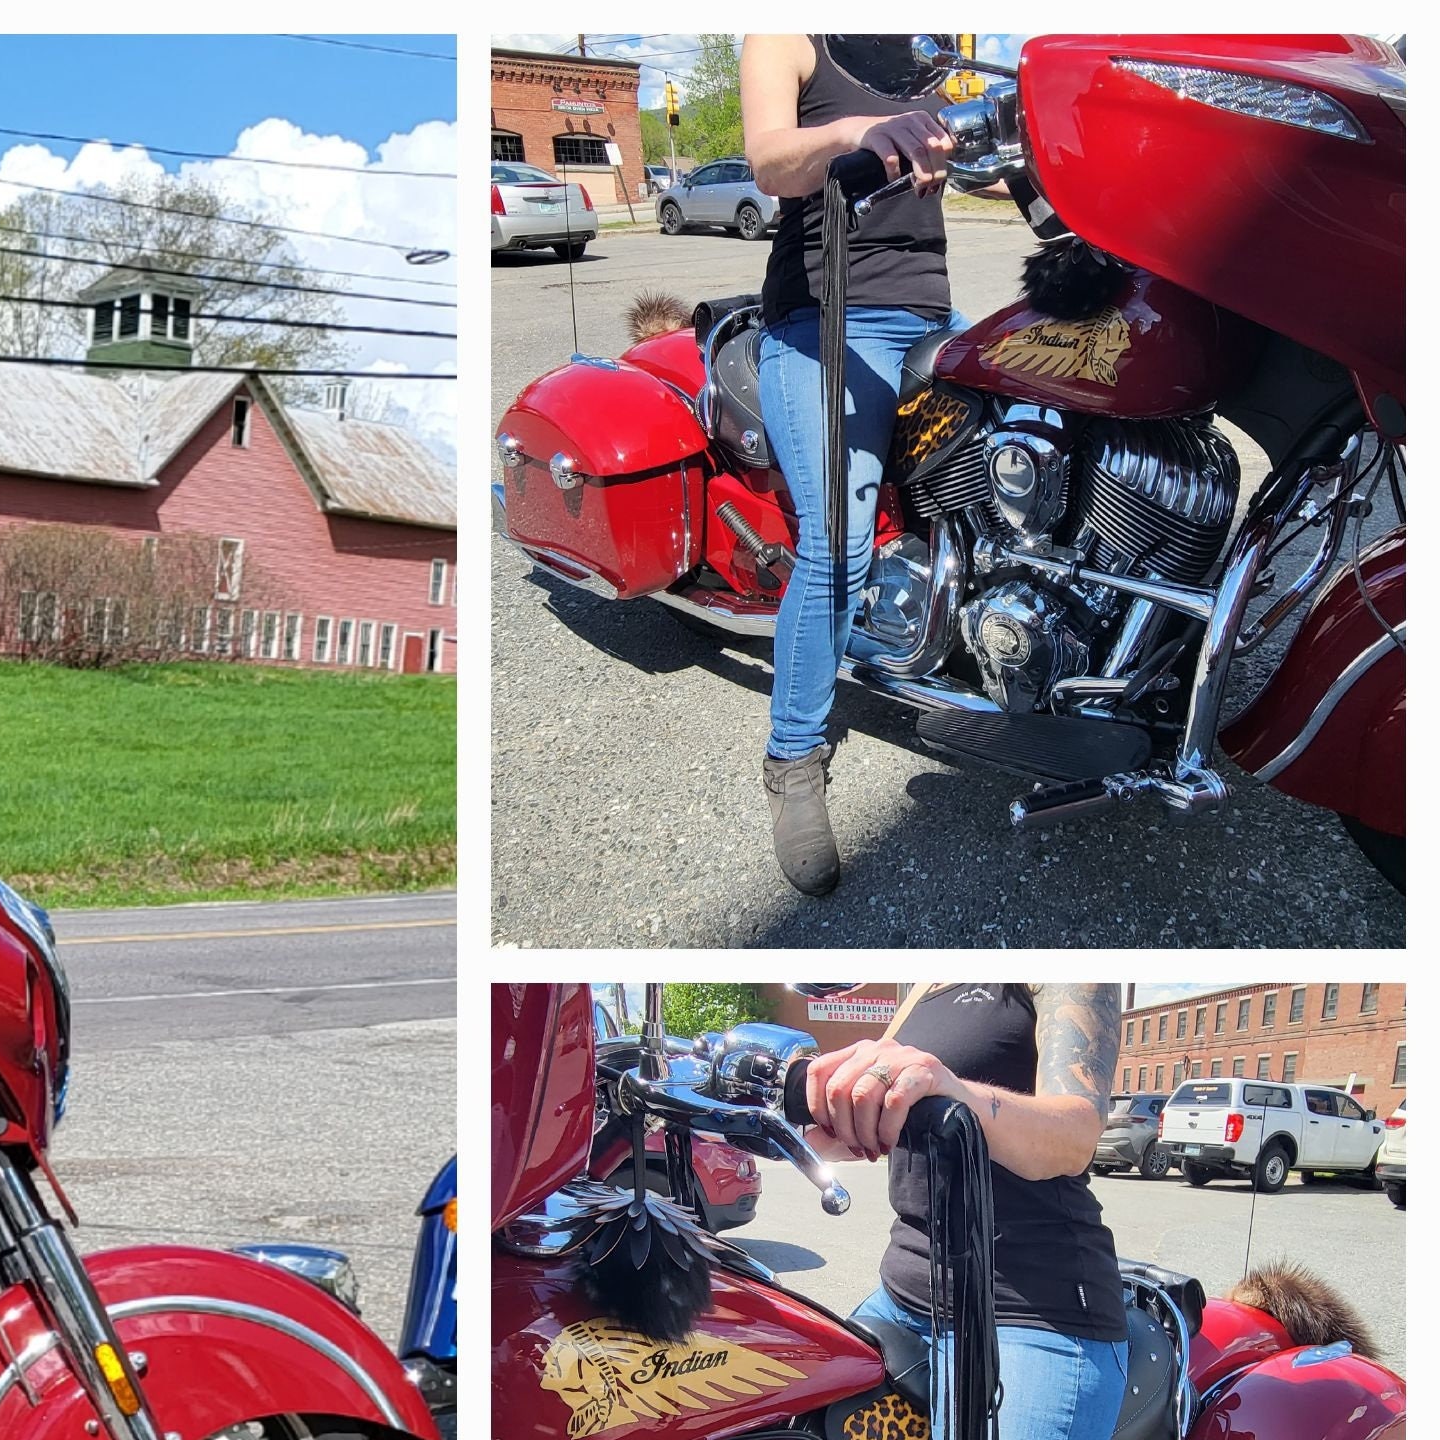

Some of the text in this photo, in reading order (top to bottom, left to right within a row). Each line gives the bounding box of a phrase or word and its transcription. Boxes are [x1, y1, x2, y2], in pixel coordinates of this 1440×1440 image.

[1024, 325, 1080, 349] Indian
[827, 1012, 895, 1020] 603-542-2332
[846, 1005, 882, 1013] STORAGE
[631, 1349, 729, 1384] Indian
